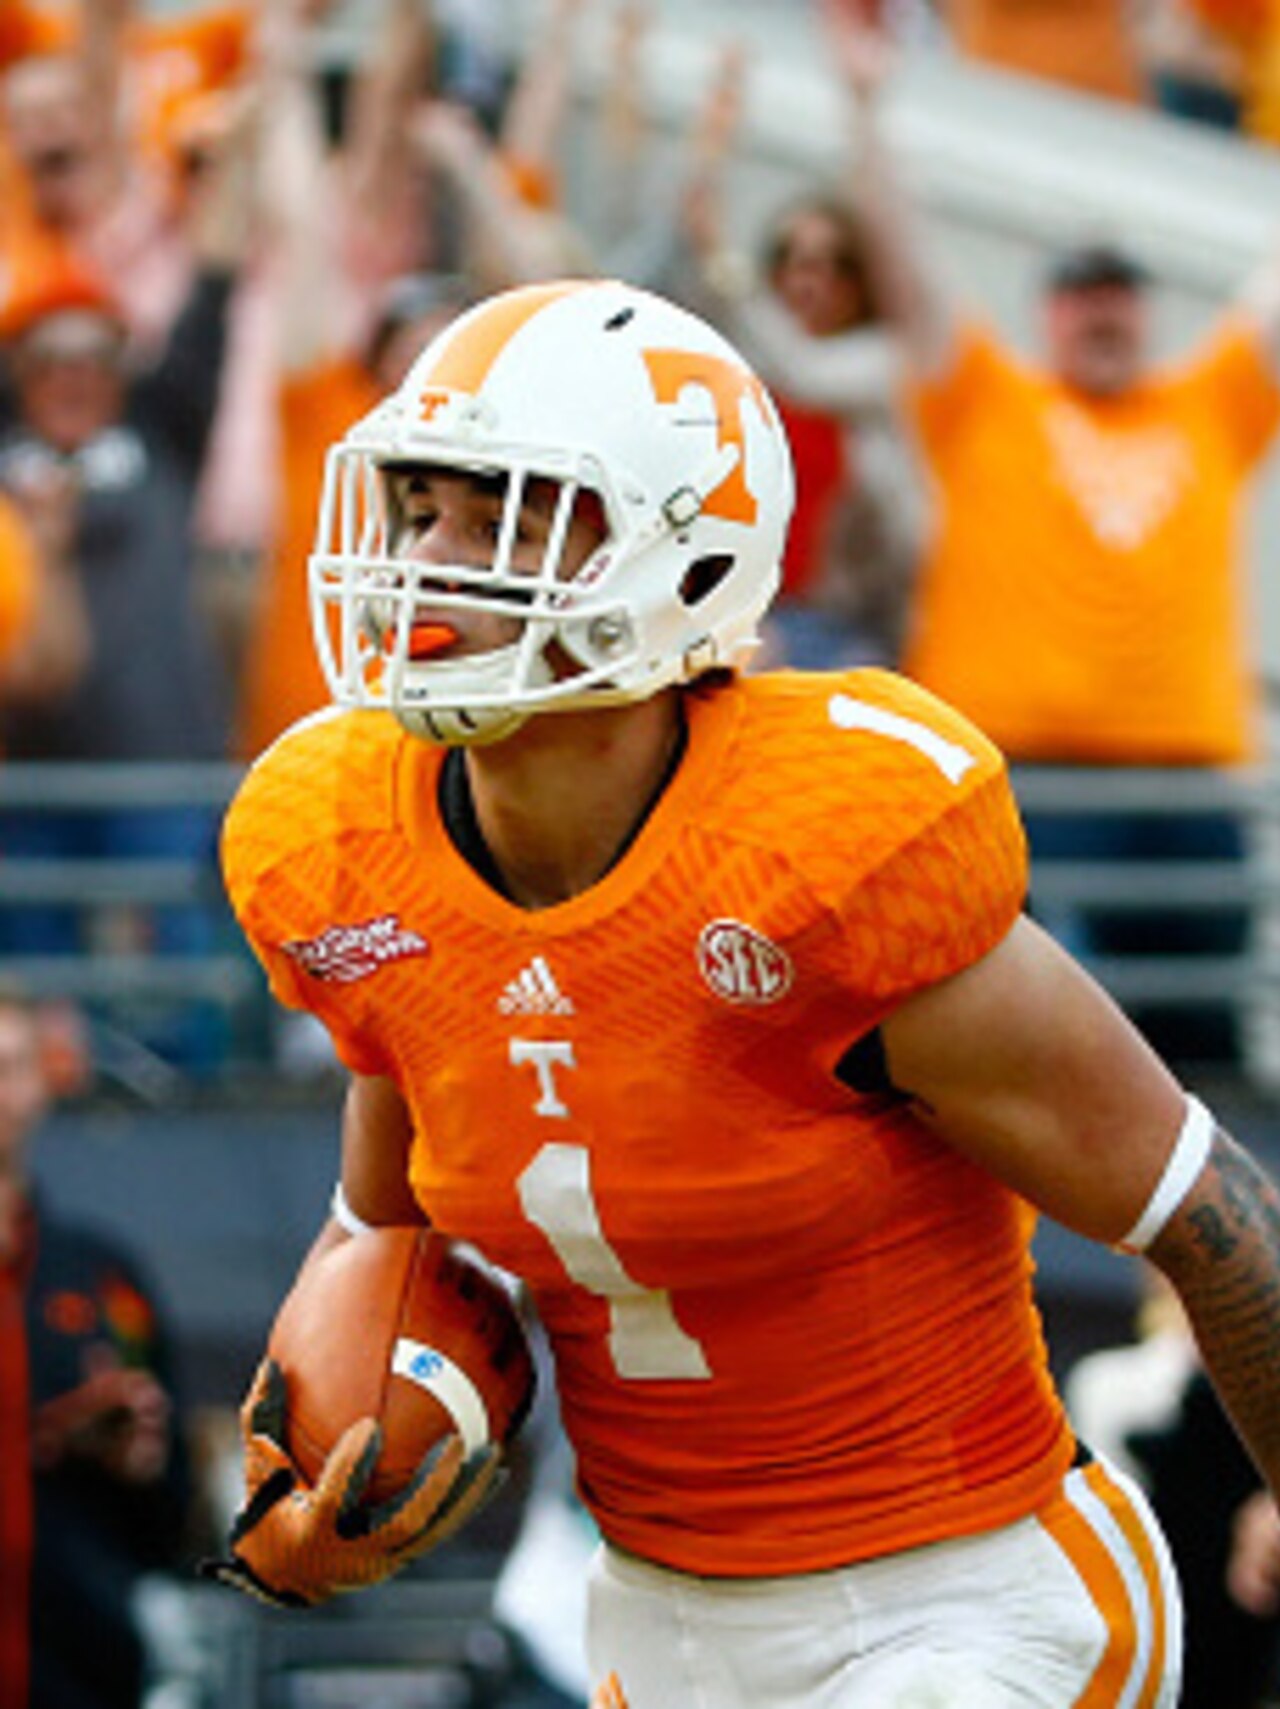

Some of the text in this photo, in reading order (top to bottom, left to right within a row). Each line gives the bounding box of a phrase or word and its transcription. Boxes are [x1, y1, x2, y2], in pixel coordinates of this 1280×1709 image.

[418, 392, 450, 422] T
[828, 693, 977, 786] 1
[708, 929, 781, 993] SEC
[508, 1036, 577, 1117] T
[514, 1142, 713, 1380] 1
